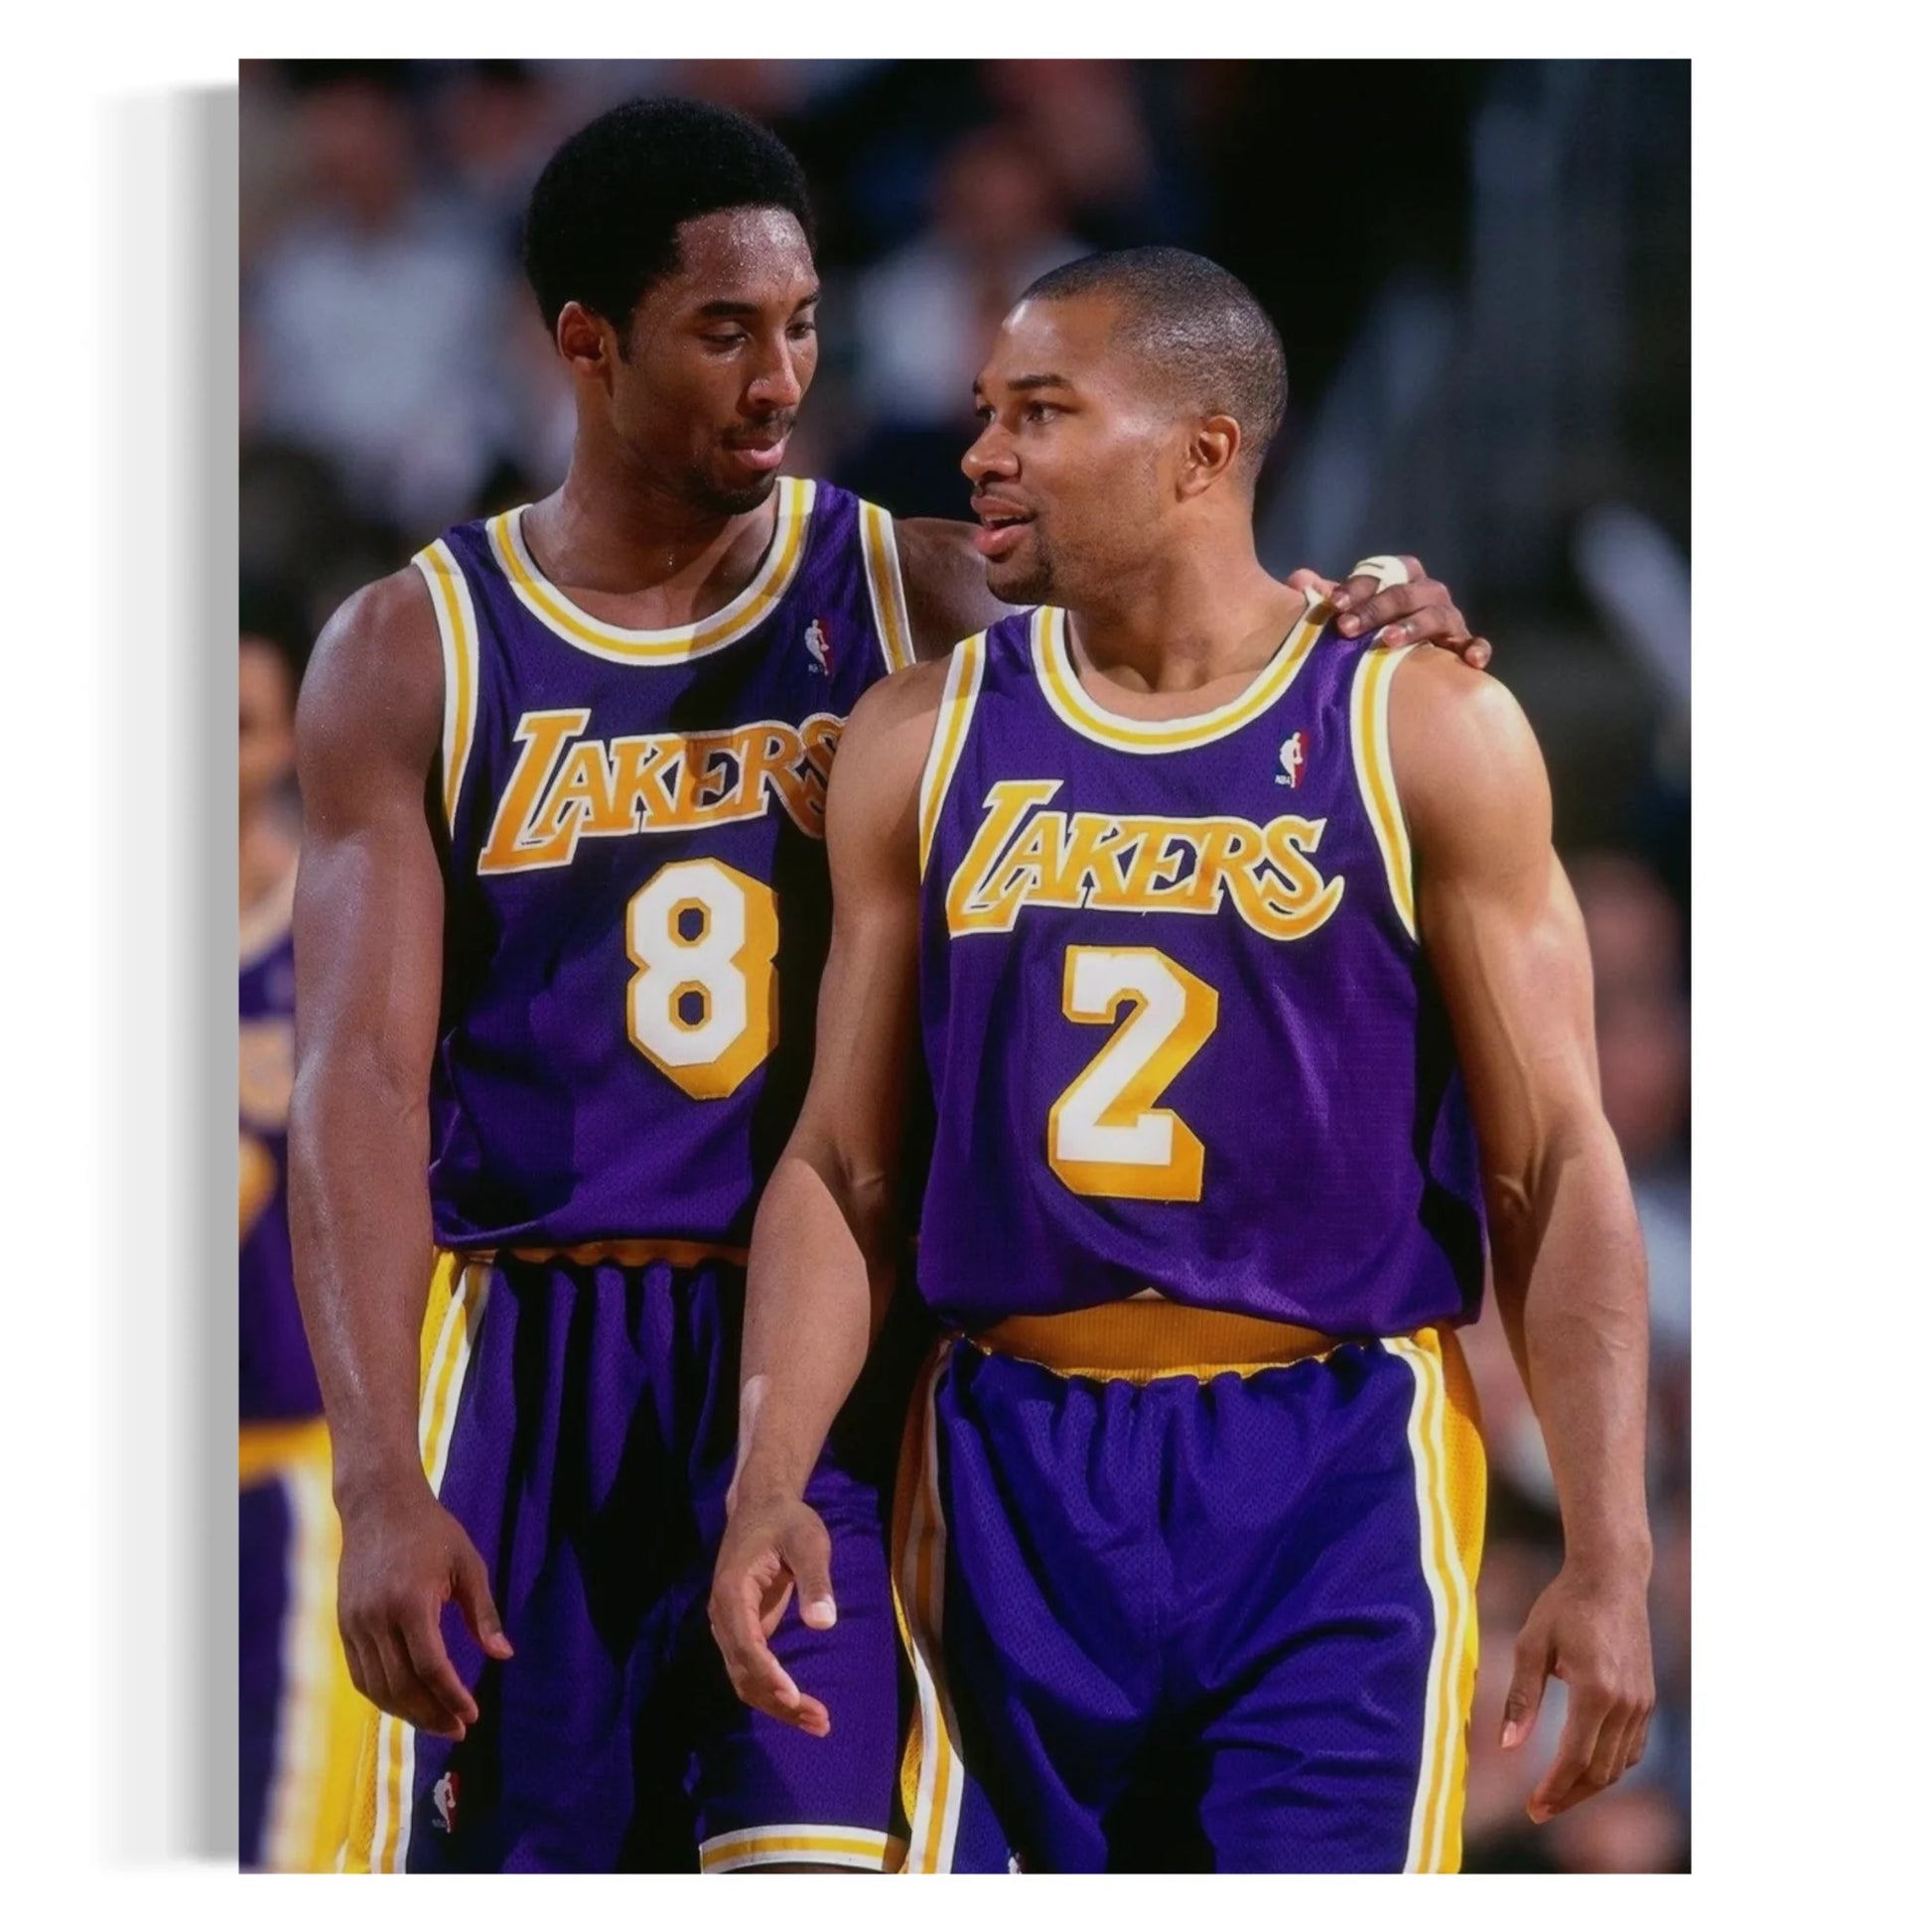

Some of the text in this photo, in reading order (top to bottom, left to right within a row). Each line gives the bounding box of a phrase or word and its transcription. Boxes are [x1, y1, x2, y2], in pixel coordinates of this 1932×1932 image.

[625, 857, 779, 1100] 8
[945, 779, 1345, 940] LAKERS
[1047, 945, 1219, 1202] 2
